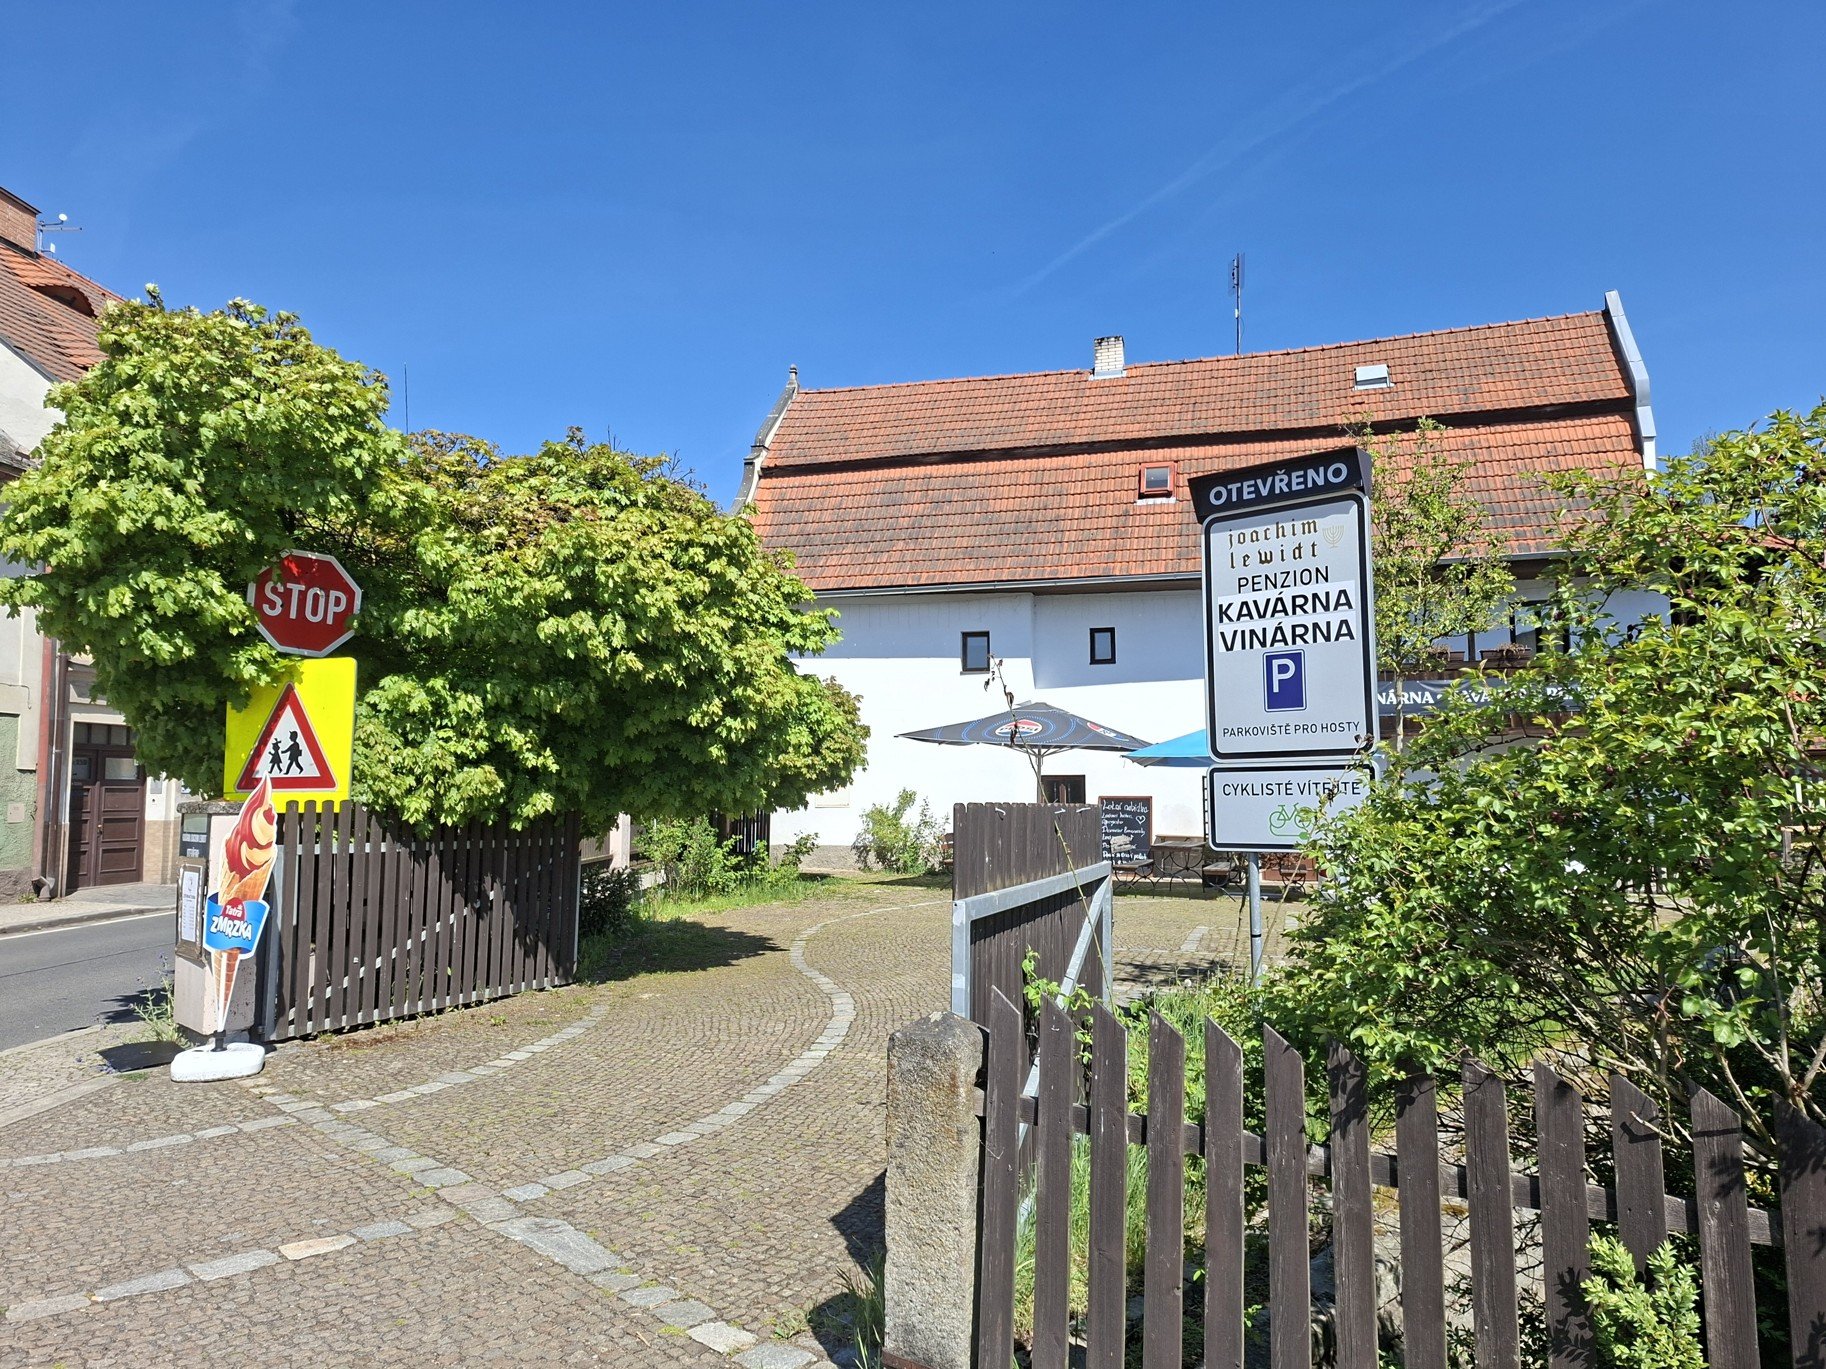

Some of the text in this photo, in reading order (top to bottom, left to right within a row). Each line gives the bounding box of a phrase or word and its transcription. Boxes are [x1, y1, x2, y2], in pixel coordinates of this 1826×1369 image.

[1209, 462, 1348, 506] OTEVŘENO
[1230, 541, 1319, 569] lewidt
[1238, 565, 1329, 594] PENZION
[262, 581, 347, 625] STOP
[1218, 589, 1354, 624] KAVÁRNA
[1219, 618, 1356, 652] VINÁRNA
[1272, 658, 1296, 693] P
[1222, 721, 1360, 738] PARKOVIŠTĚ PRO HOSTY
[1222, 780, 1294, 797] CYKLISTÉ
[225, 904, 243, 918] Tatra
[209, 915, 253, 941] ZMRZKA
